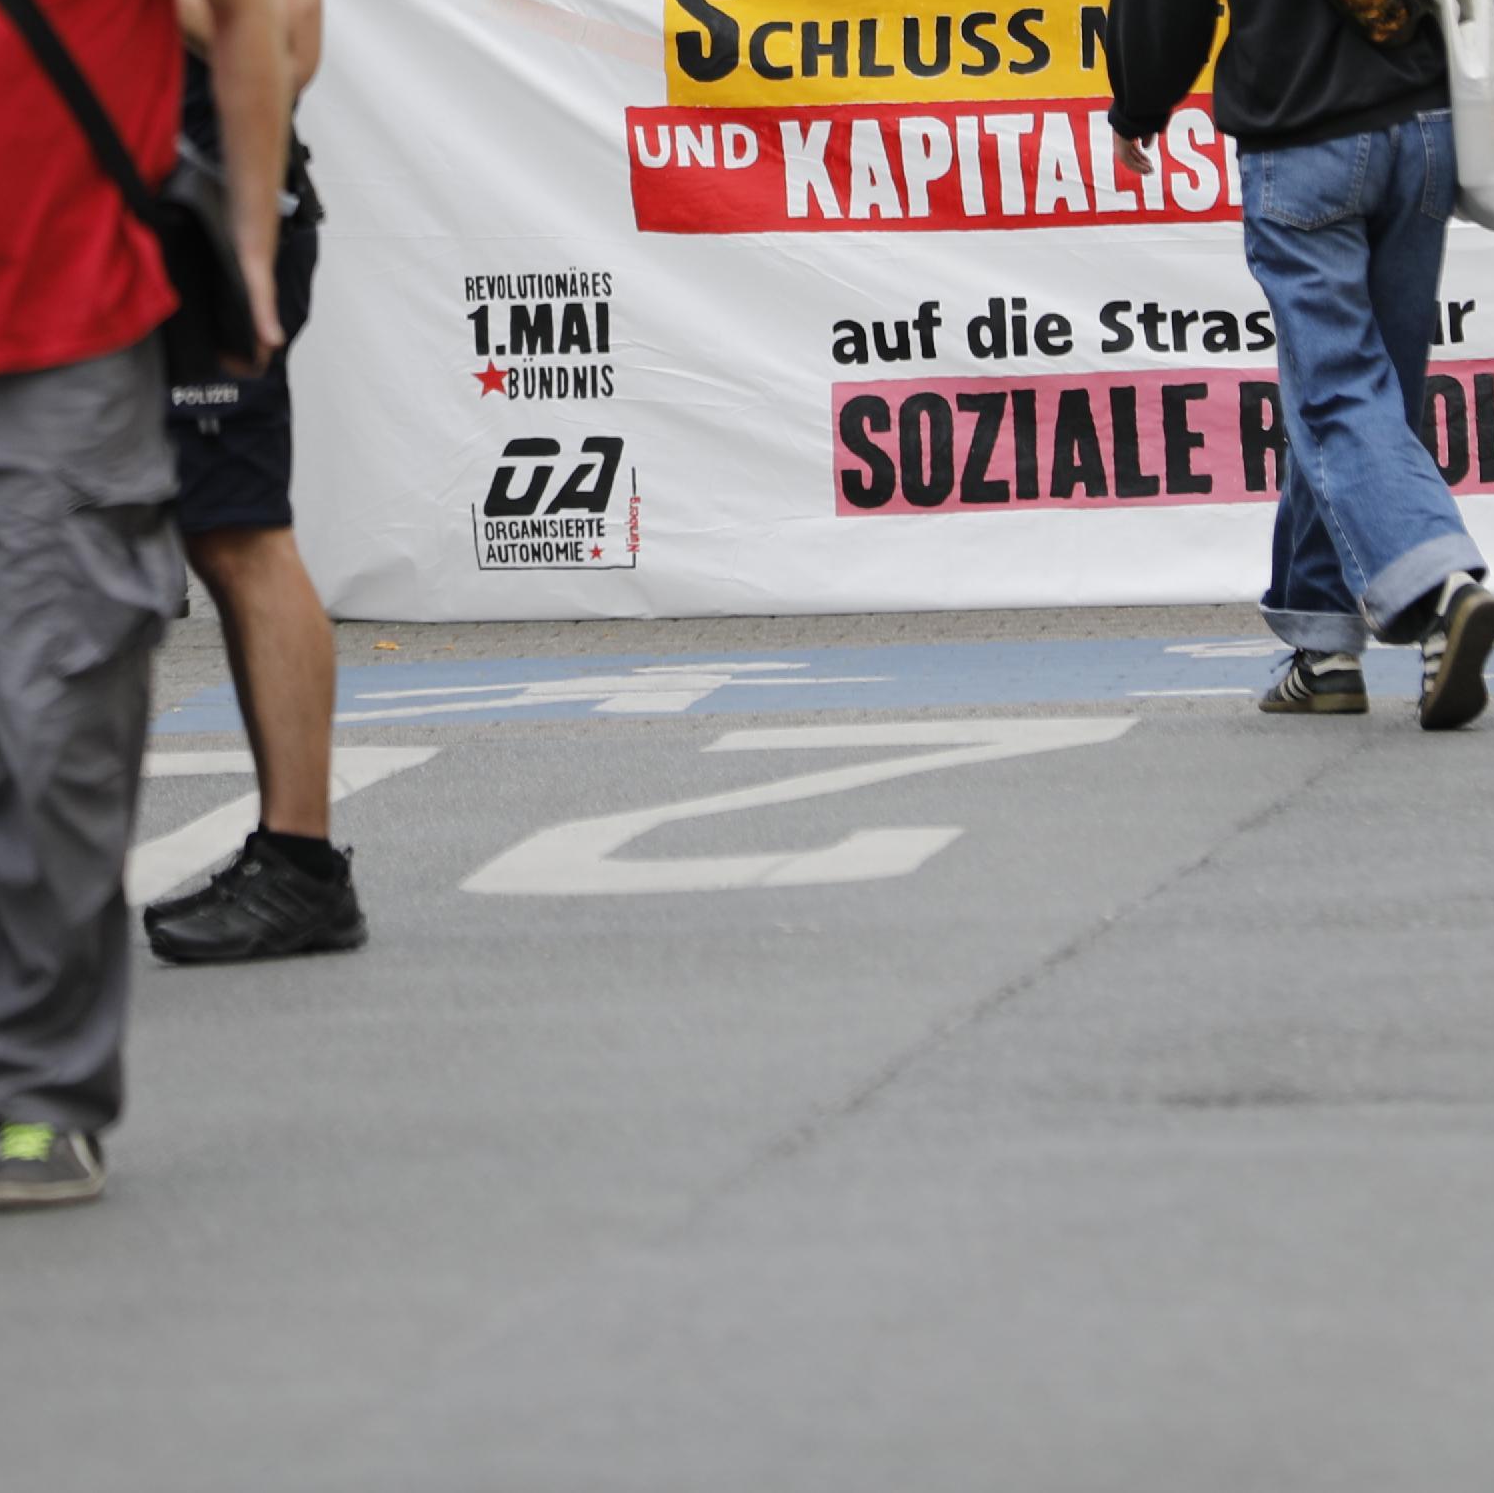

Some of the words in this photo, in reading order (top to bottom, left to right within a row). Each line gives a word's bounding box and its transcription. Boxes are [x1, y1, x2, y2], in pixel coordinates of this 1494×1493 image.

[635, 122, 758, 171] UND
[778, 106, 1242, 220] KAPITALIS
[465, 266, 613, 302] REVOLUTIONÄRES
[467, 302, 610, 357] 1.MAI
[832, 301, 942, 365] auf
[967, 297, 1073, 360] die
[1100, 300, 1277, 355] Stras
[171, 383, 239, 405] POLIZEI
[507, 357, 615, 400] BÜNDNIS
[839, 382, 1213, 509] SOZIALE
[484, 518, 606, 541] ORGANISIERTE
[626, 494, 642, 554] Nürnberg
[485, 541, 585, 564] AUTONOMIE
